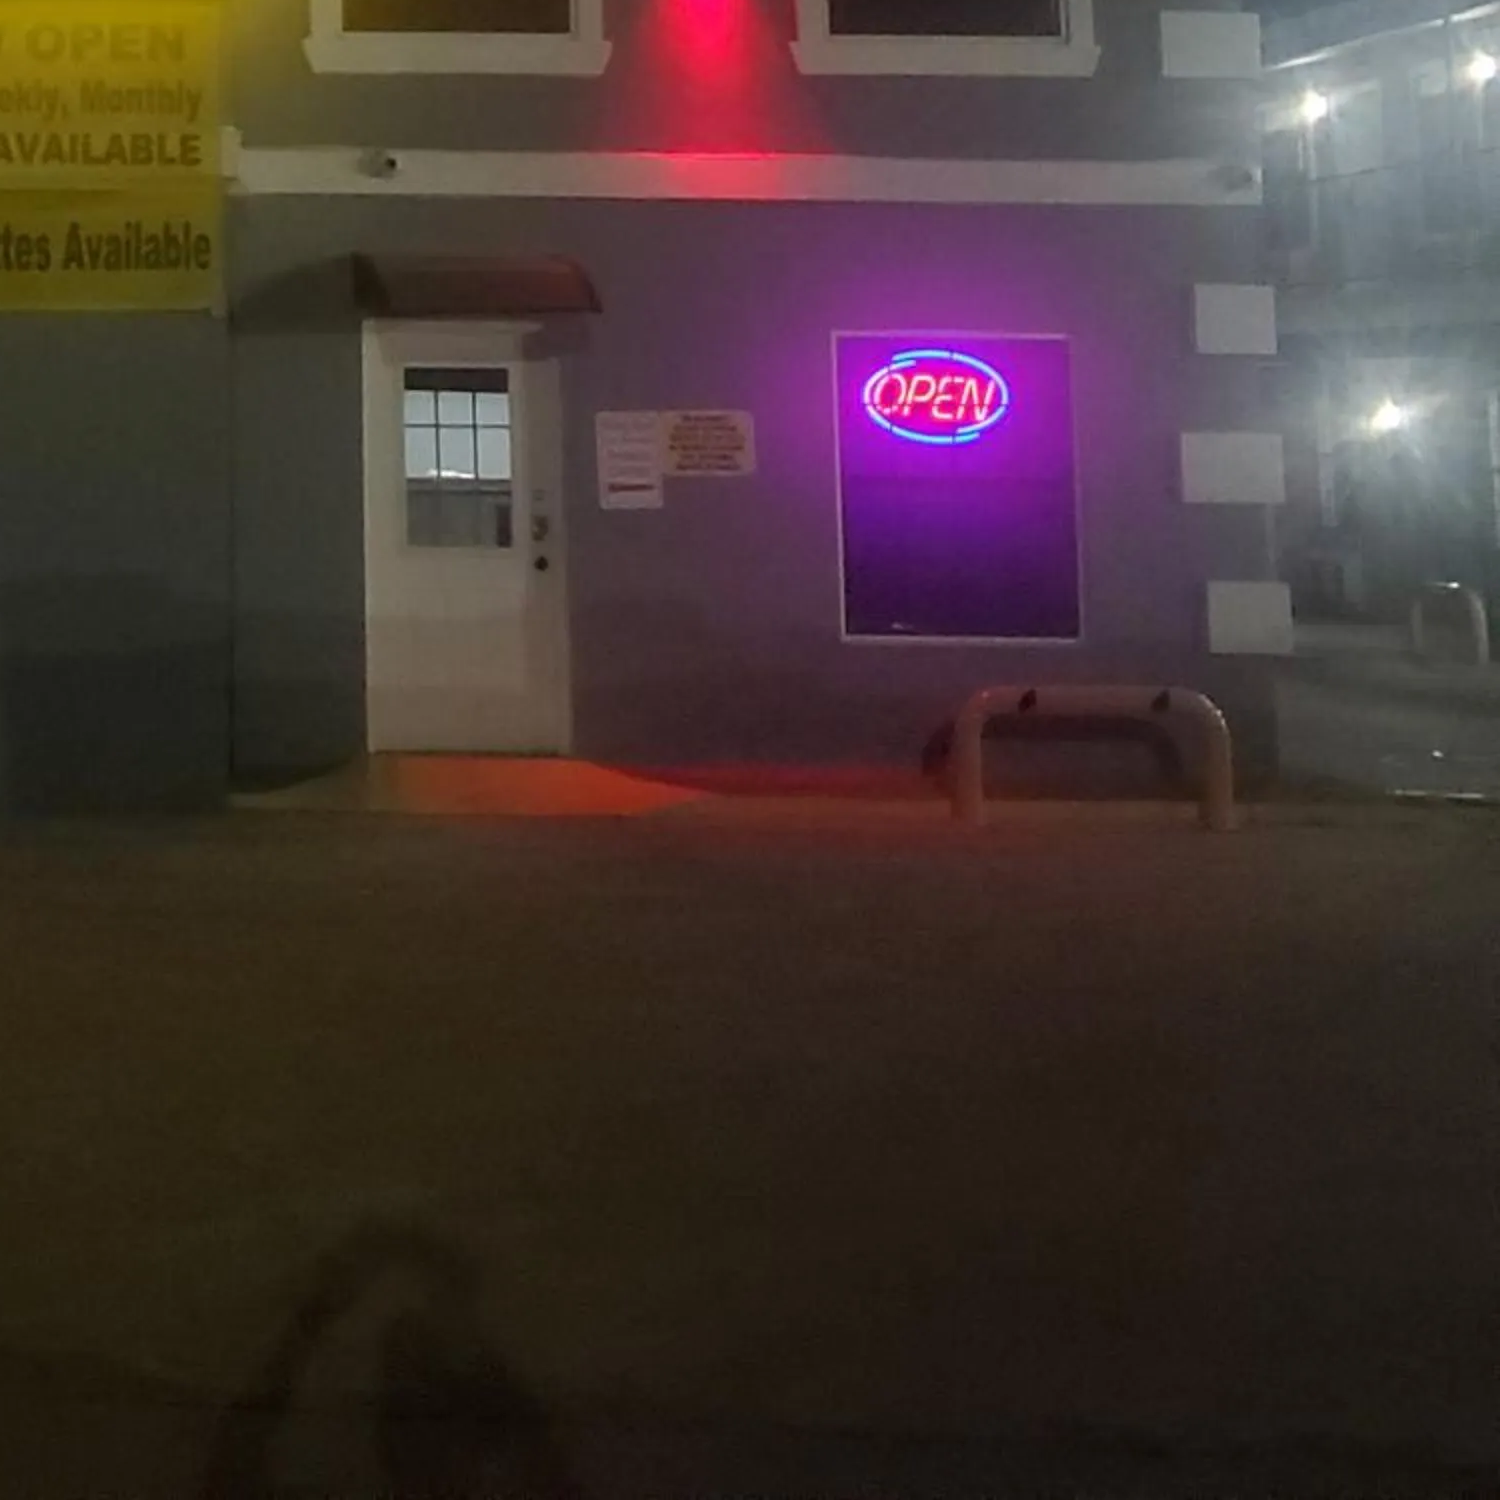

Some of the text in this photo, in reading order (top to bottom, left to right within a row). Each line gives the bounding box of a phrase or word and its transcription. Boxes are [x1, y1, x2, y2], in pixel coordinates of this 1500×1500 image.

[25, 22, 187, 63] OPEN
[80, 79, 203, 122] Monthly
[61, 220, 212, 272] Available
[873, 372, 995, 422] OPEN
